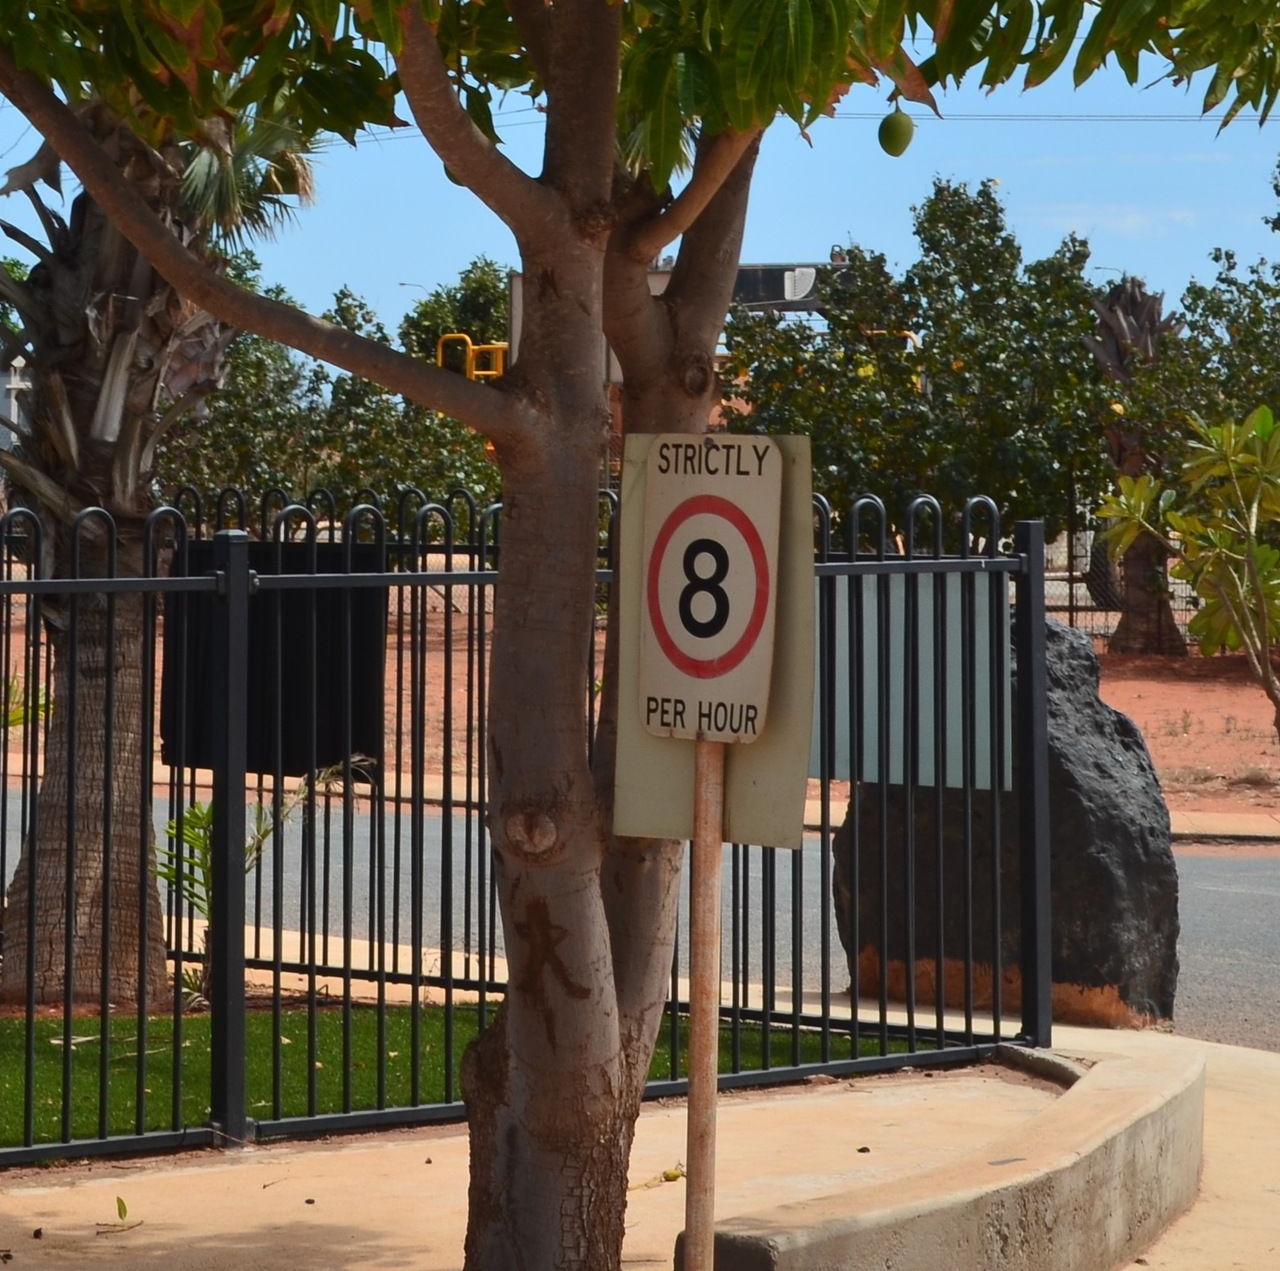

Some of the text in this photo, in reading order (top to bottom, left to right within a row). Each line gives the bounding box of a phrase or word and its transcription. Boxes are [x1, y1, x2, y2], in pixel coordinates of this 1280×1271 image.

[658, 442, 771, 476] STRICTLY
[678, 538, 730, 639] 8
[646, 696, 758, 735] PER HOUR
